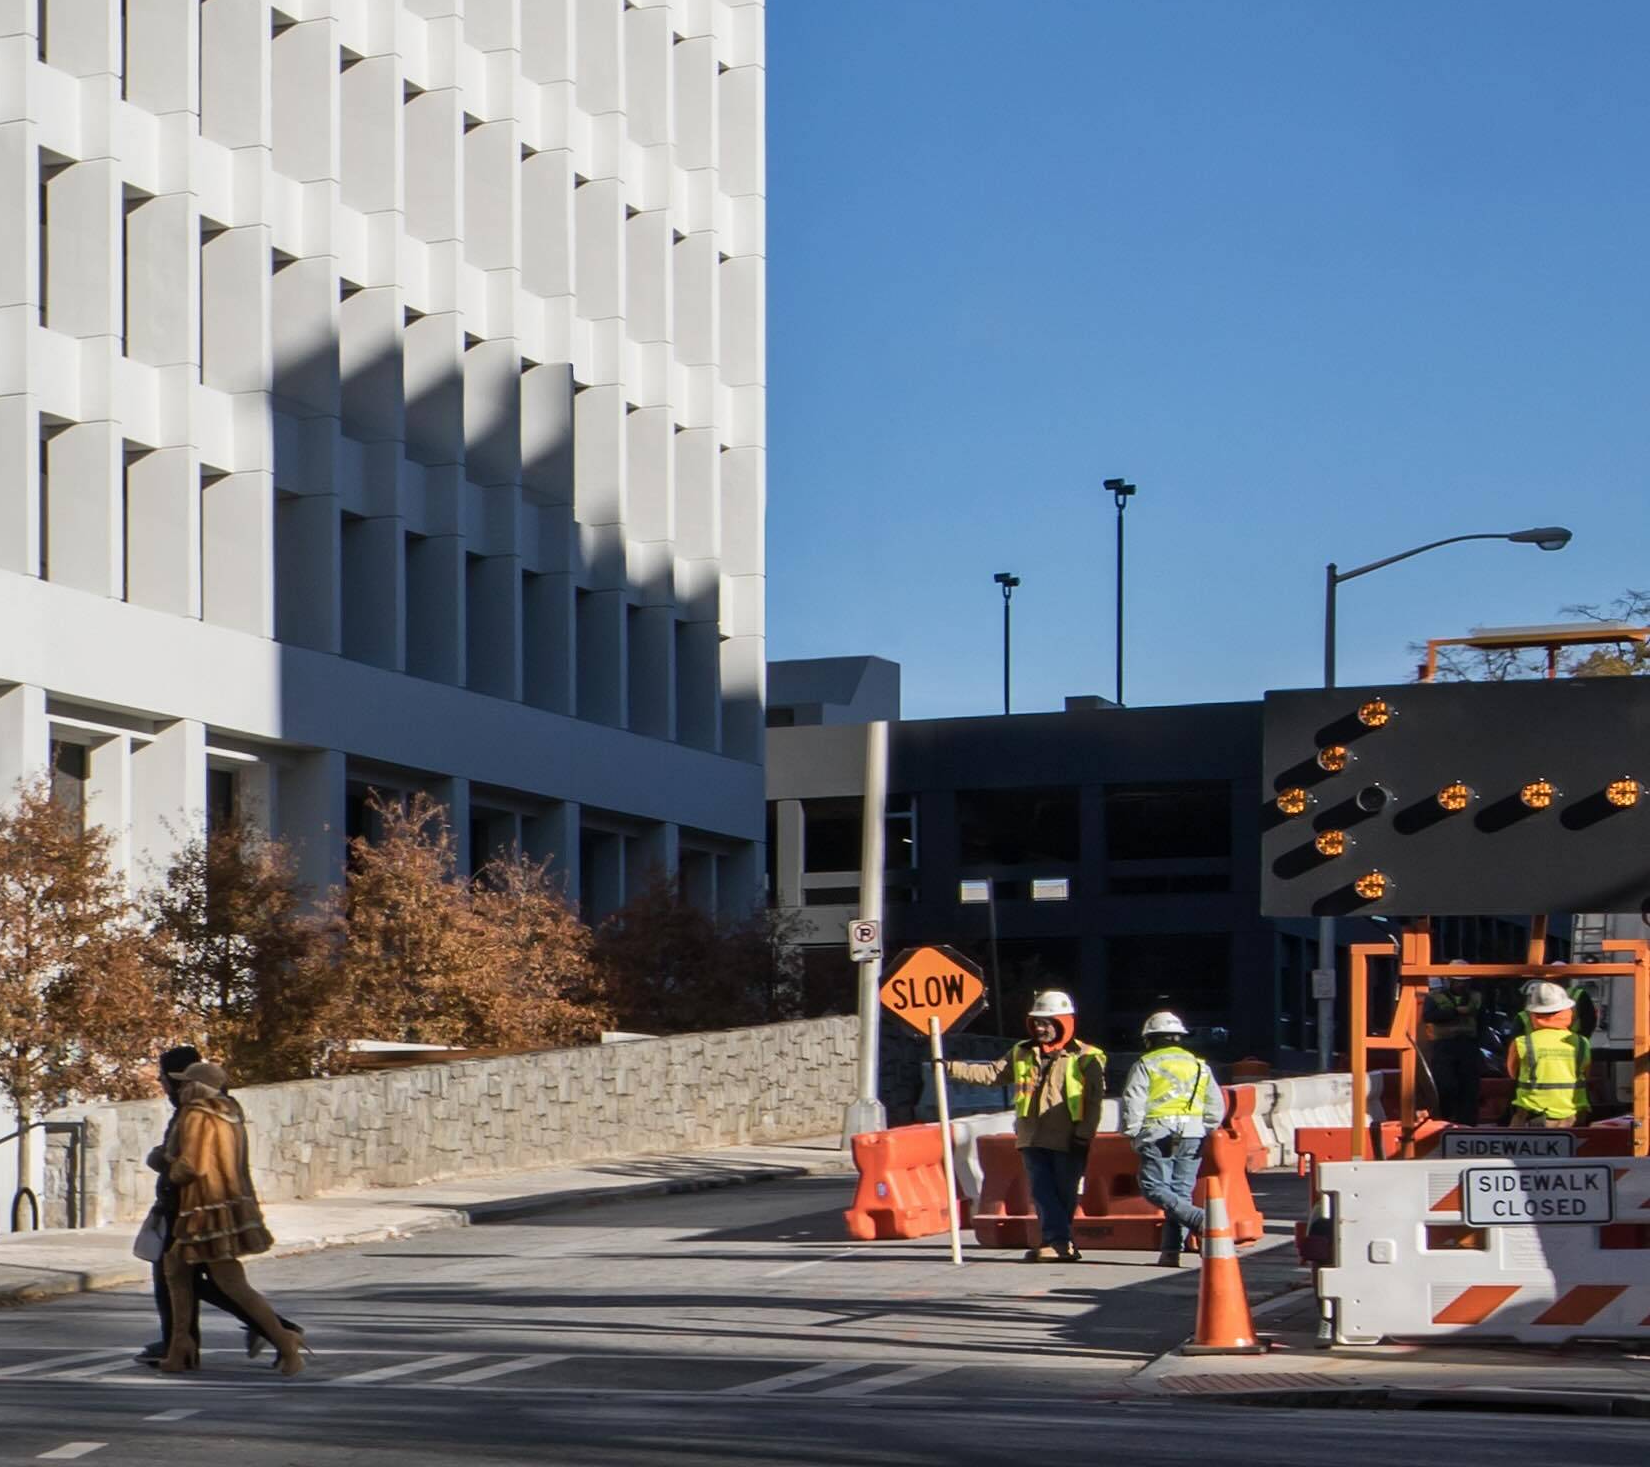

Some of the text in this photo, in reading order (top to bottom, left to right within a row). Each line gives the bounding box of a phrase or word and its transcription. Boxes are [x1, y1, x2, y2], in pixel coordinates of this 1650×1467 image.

[891, 973, 965, 1010] SLOW
[1456, 1139, 1560, 1156] SIDEWALK
[1478, 1172, 1599, 1193] SIDEWALK
[1493, 1198, 1587, 1217] CLOSED
